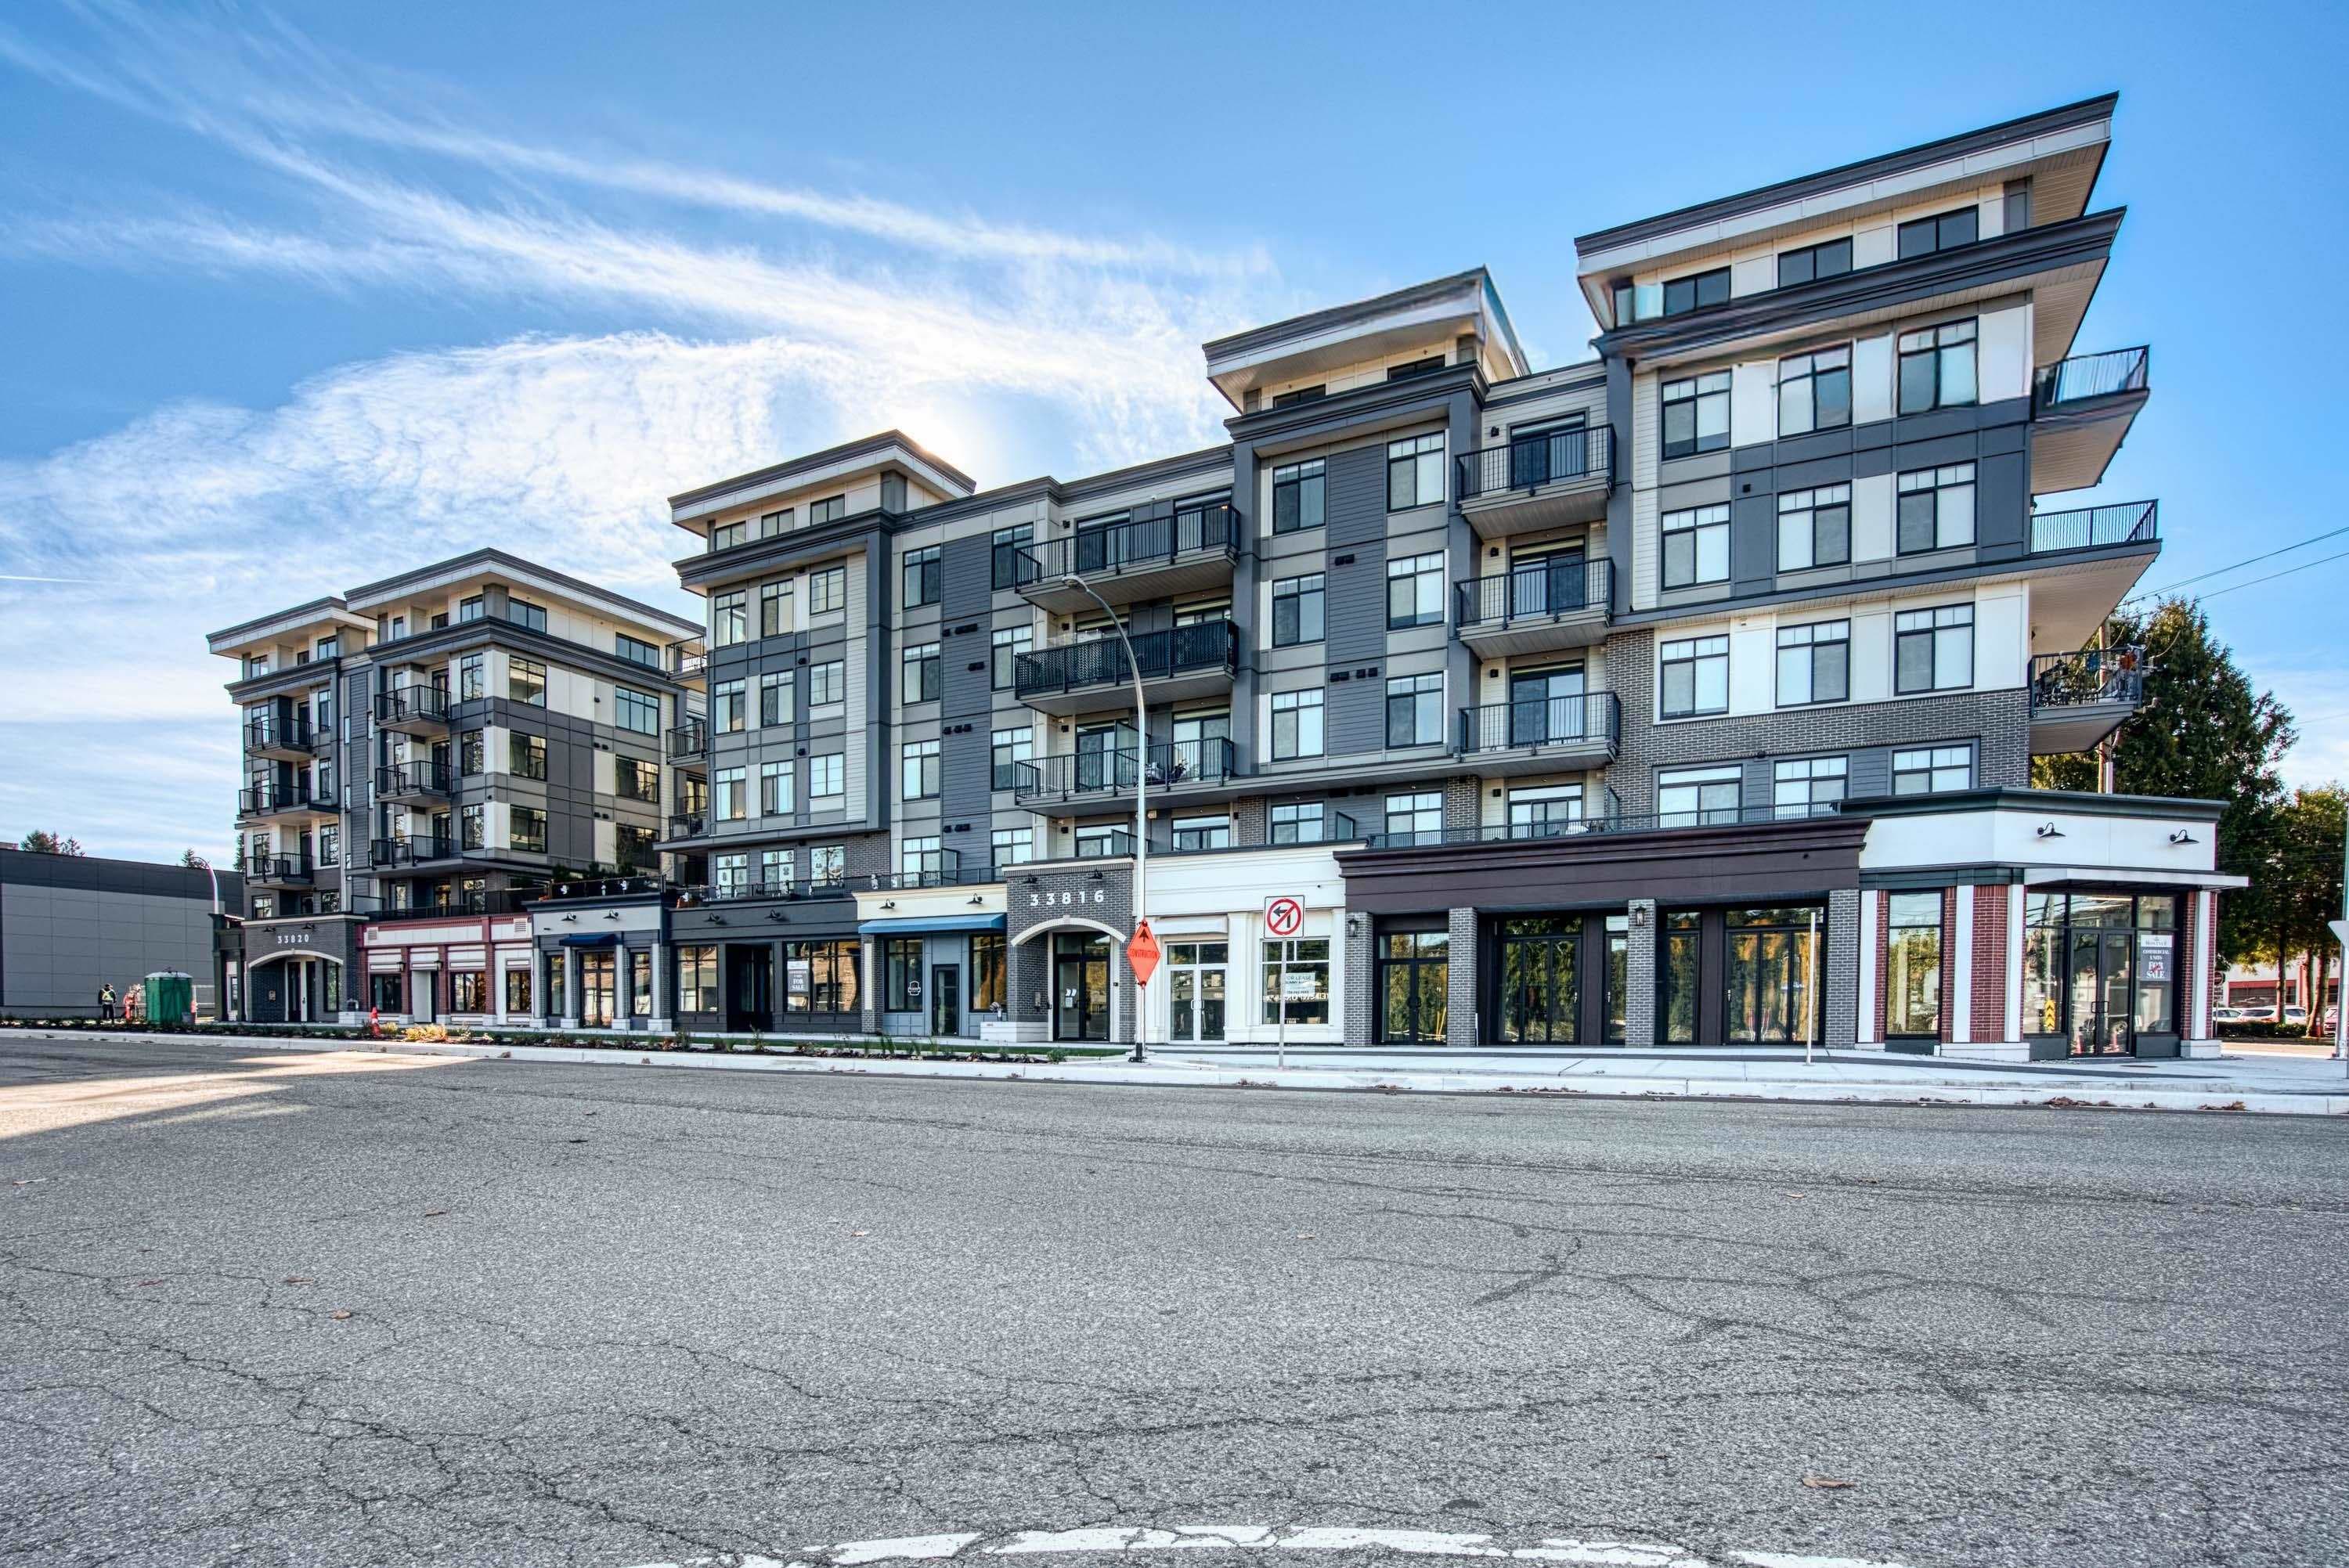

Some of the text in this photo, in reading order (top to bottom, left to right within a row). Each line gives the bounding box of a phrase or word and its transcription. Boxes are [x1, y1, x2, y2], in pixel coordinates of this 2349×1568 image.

[1030, 890, 1104, 907] 33816
[277, 934, 309, 944] 33820
[1129, 949, 1158, 959] CONSTRUCTION
[2149, 962, 2164, 971] FOR
[2146, 971, 2165, 979] SALE
